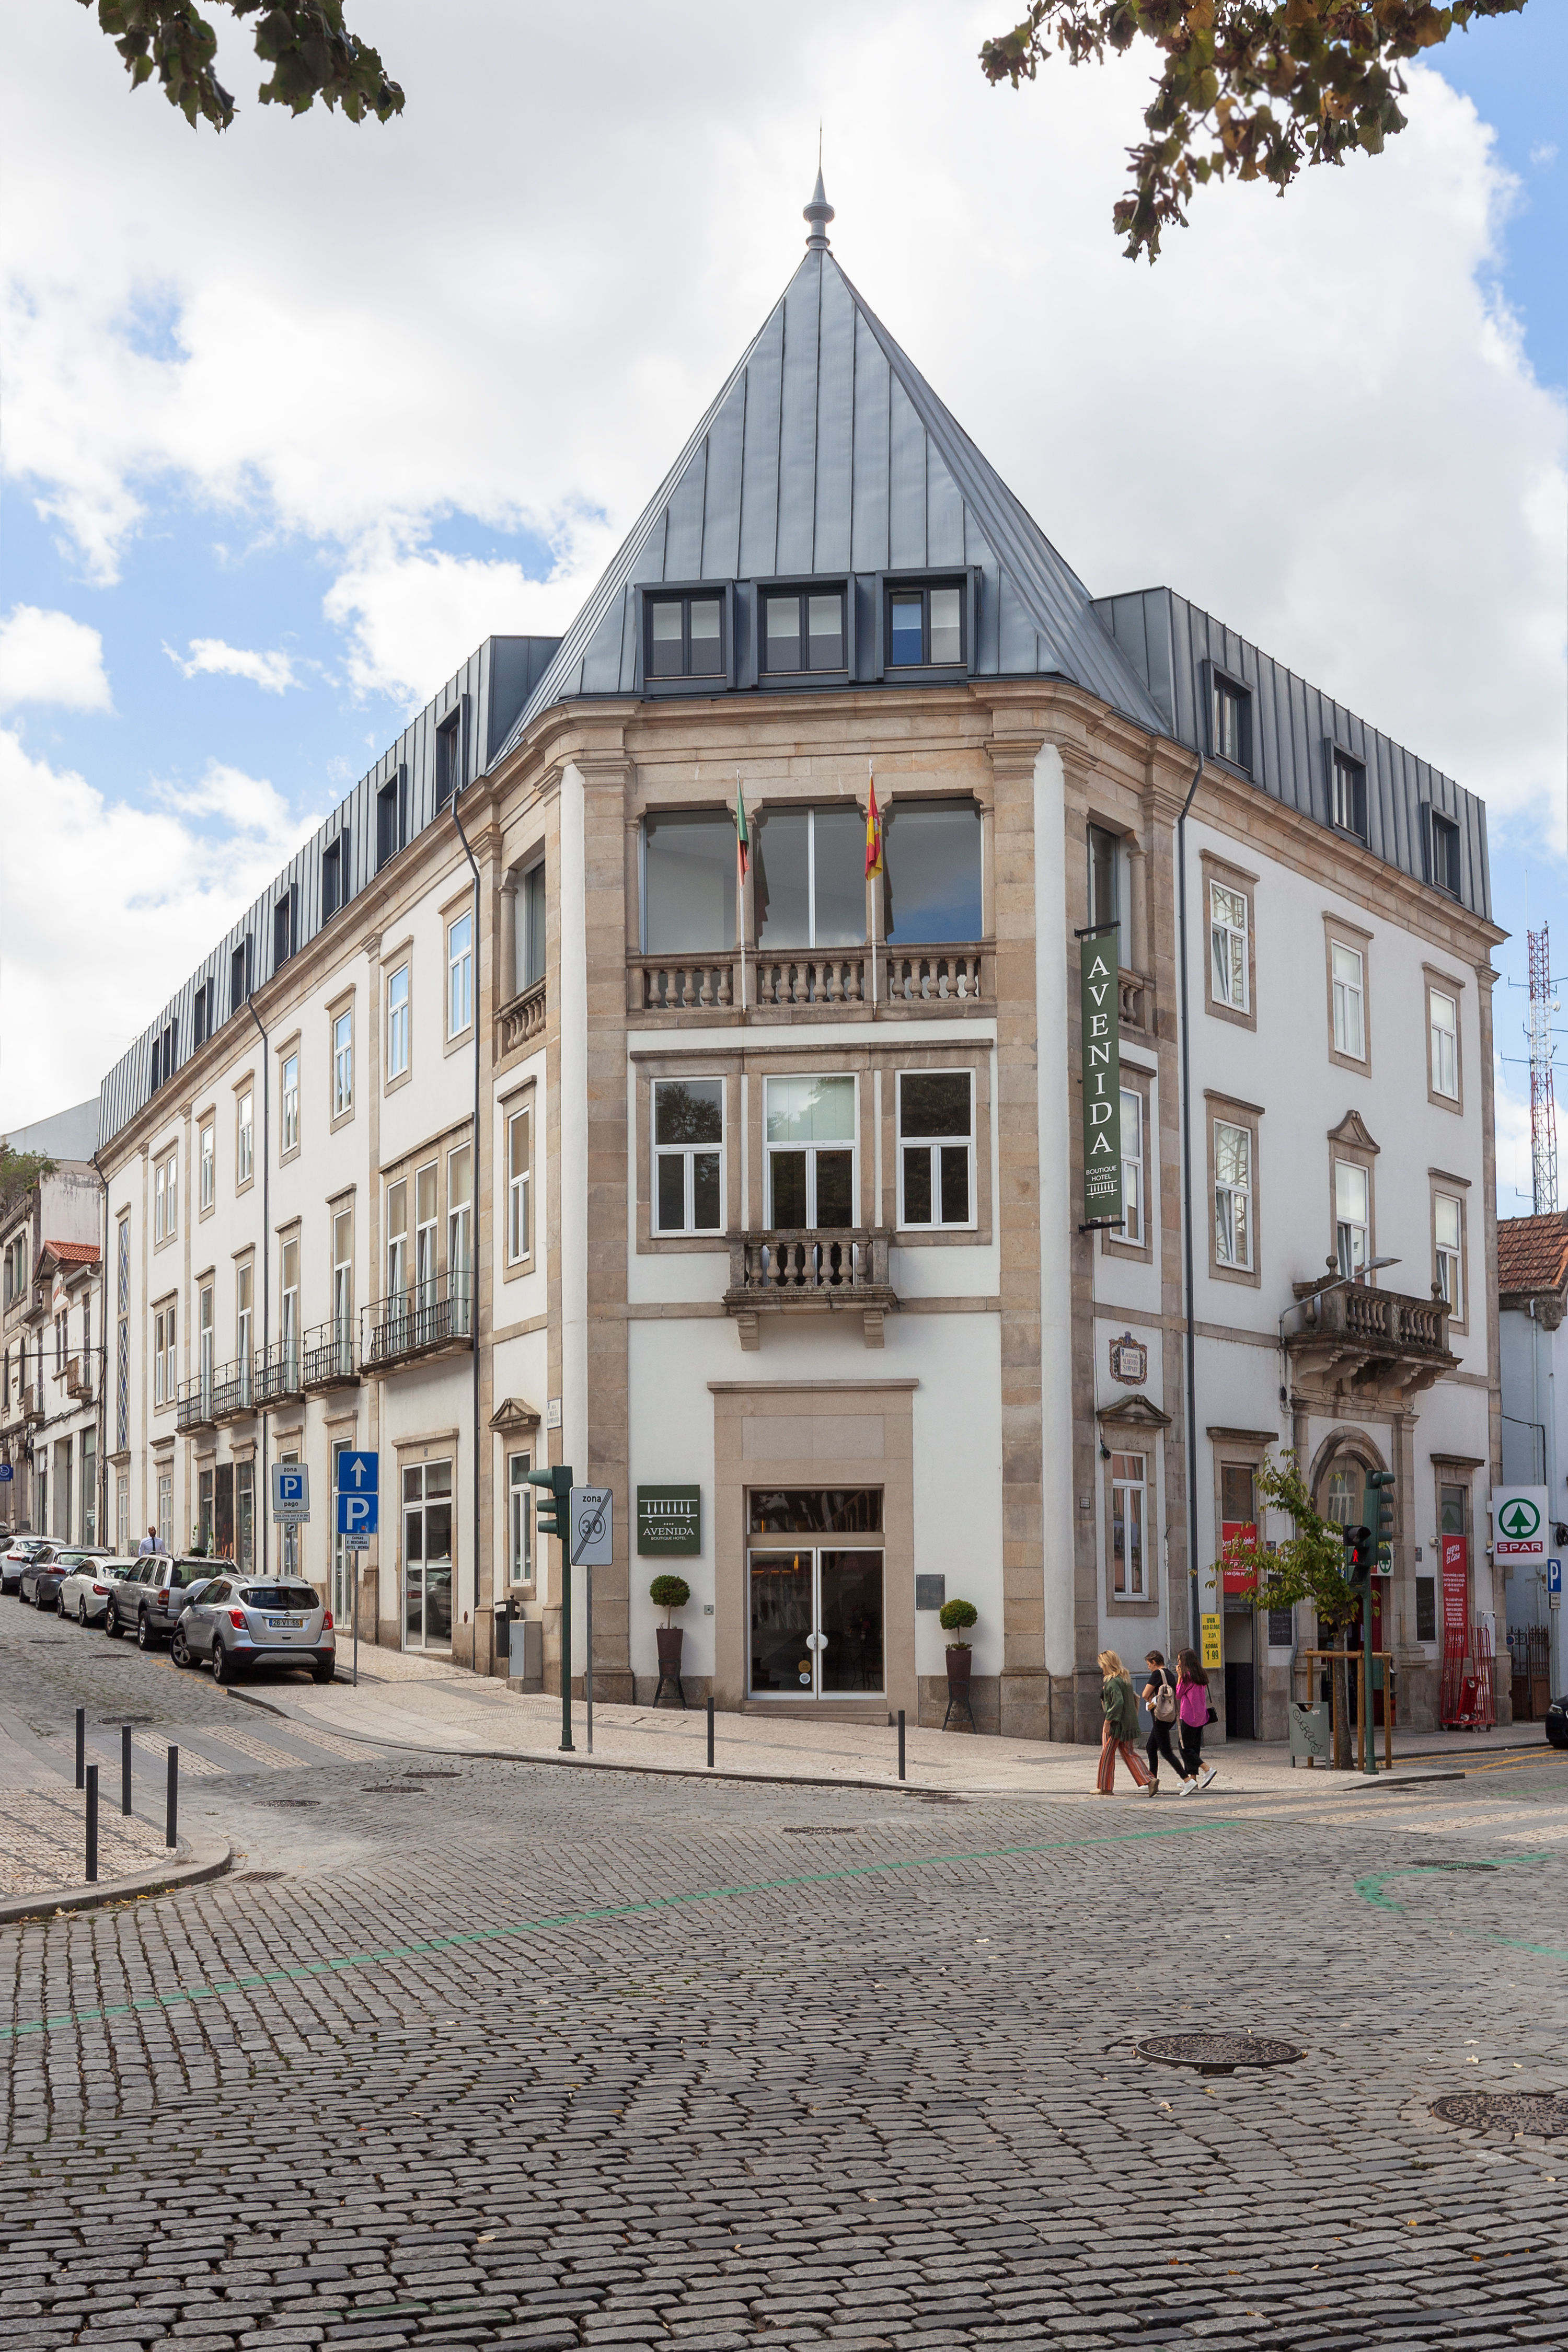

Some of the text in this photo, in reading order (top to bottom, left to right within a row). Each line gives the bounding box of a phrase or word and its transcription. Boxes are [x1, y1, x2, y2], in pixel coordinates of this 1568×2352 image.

[1087, 955, 1113, 1155] AVENIDA
[1086, 1165, 1117, 1175] BOUTIQUE
[284, 1478, 297, 1497] P
[347, 1497, 370, 1530] P
[582, 1519, 603, 1535] 30
[642, 1527, 695, 1536] AVENIDA
[1498, 1542, 1541, 1552] SPAR
[1550, 1562, 1559, 1589] P
